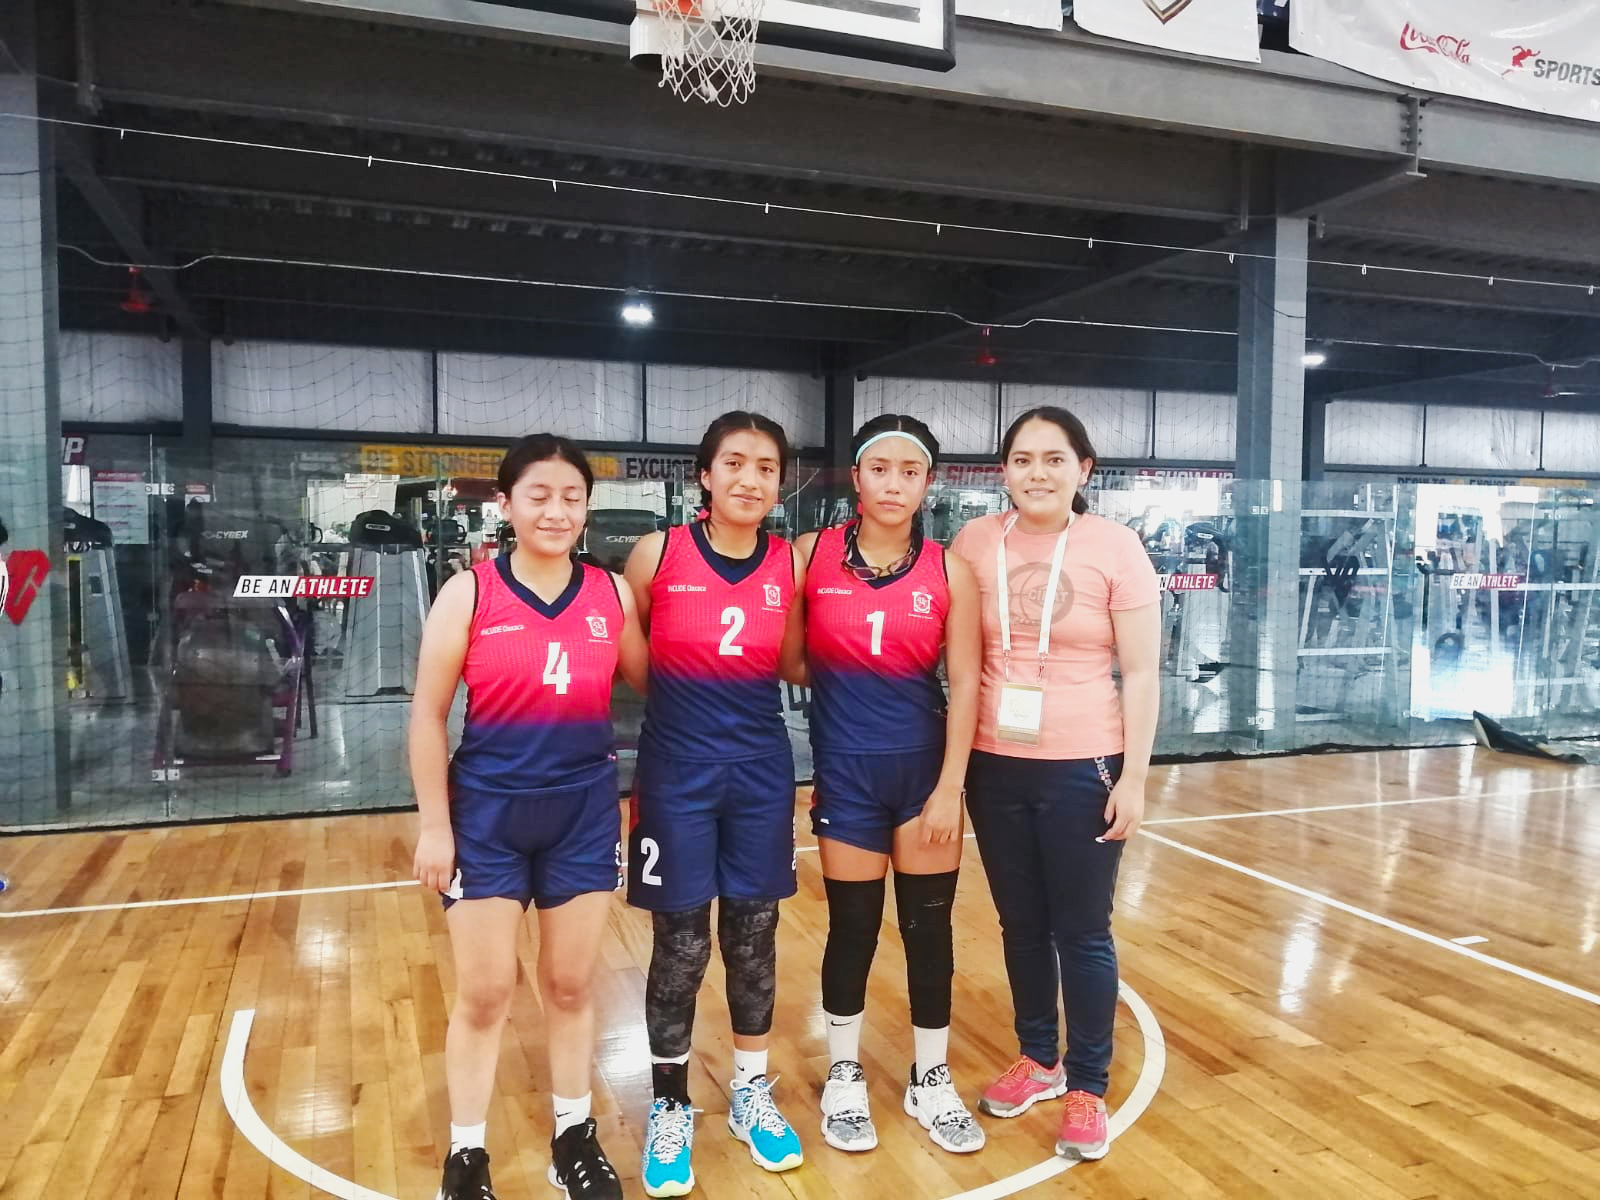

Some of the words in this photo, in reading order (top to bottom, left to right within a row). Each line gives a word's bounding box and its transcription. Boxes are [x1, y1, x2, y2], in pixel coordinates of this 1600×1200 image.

[241, 579, 263, 594] BE
[268, 579, 292, 594] AN
[296, 578, 369, 595] ATHLETE
[1168, 575, 1215, 589] ATHLETE
[1453, 575, 1465, 588] BE
[1467, 575, 1479, 588] AN
[1480, 575, 1519, 588] ATHLETE
[719, 606, 745, 656] 2
[866, 611, 885, 656] 1
[543, 642, 571, 695] 4
[640, 837, 662, 886] 2
